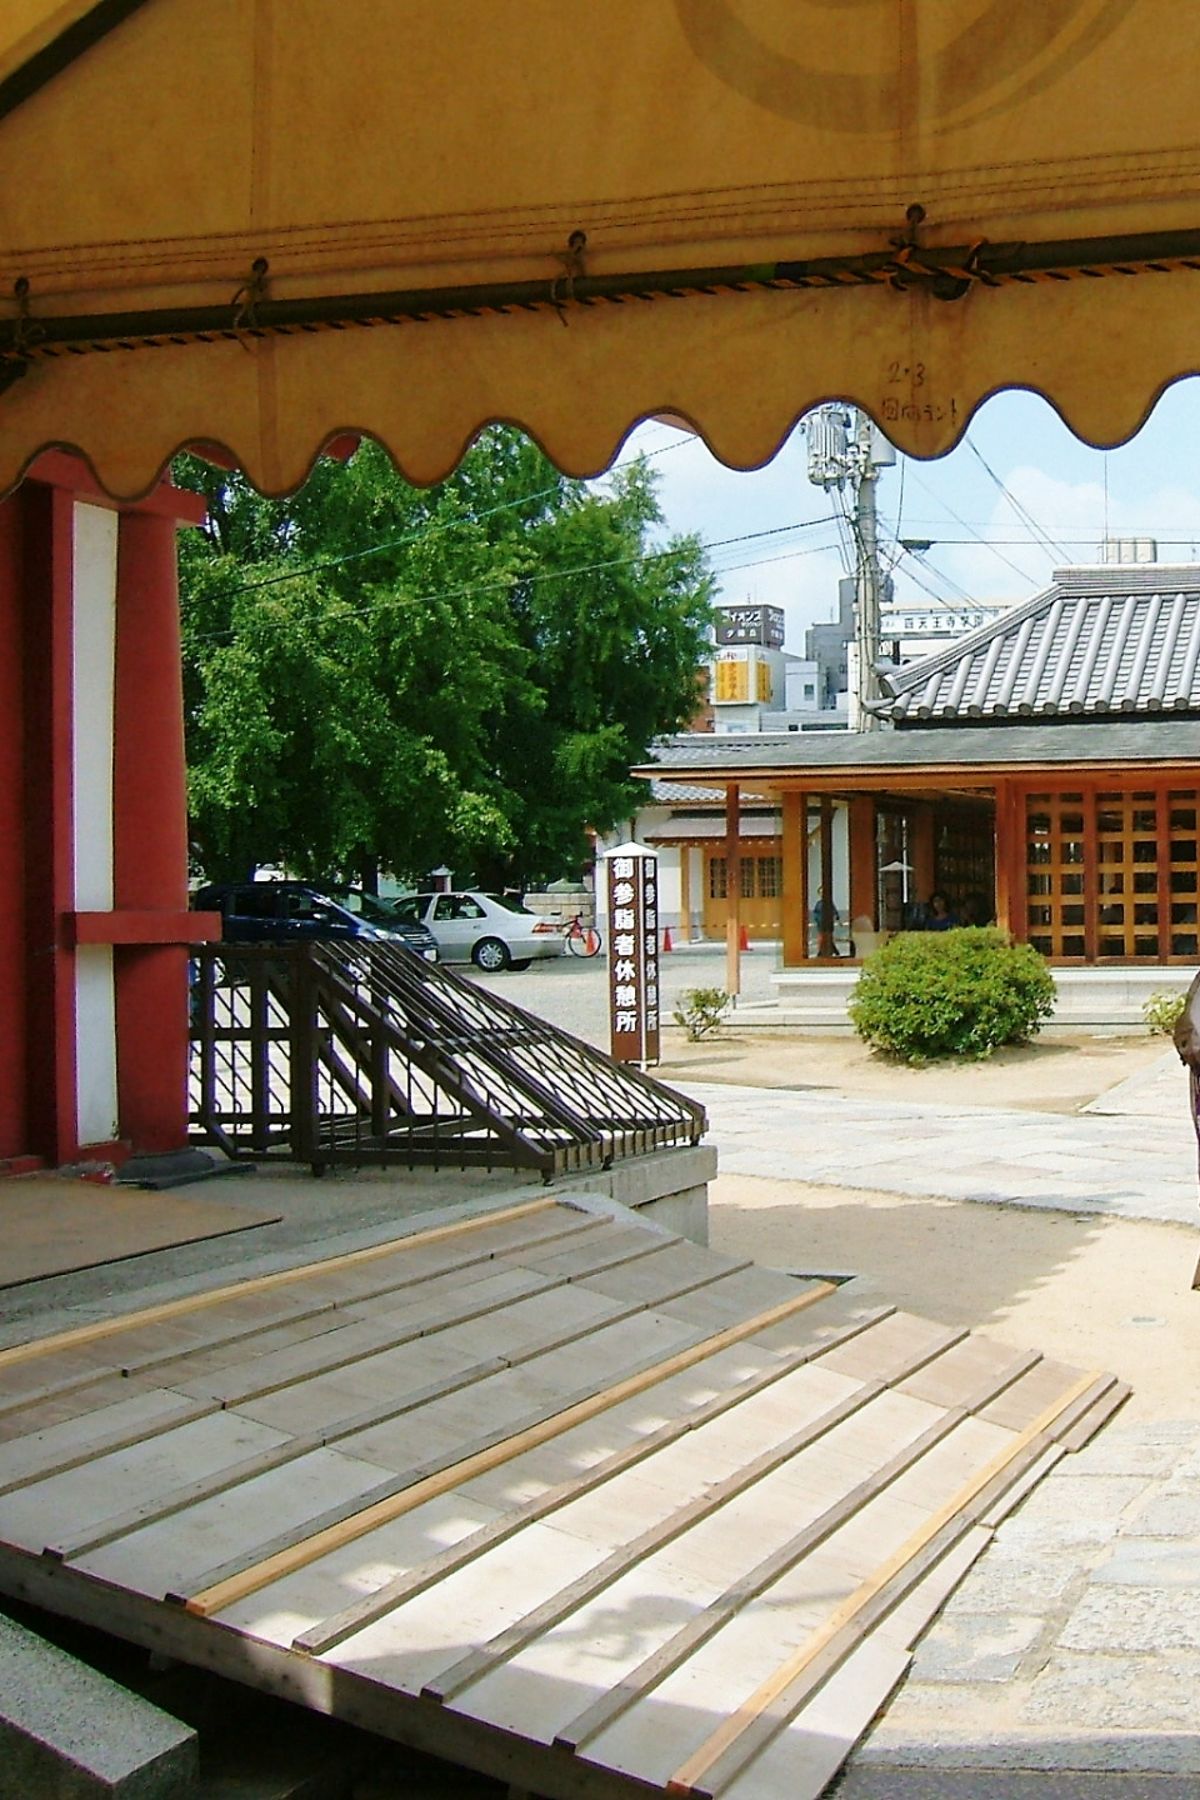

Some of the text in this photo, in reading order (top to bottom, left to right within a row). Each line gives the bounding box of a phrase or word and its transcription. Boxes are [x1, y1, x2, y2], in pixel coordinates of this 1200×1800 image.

[613, 857, 637, 1033] 御参詣者休憩所
